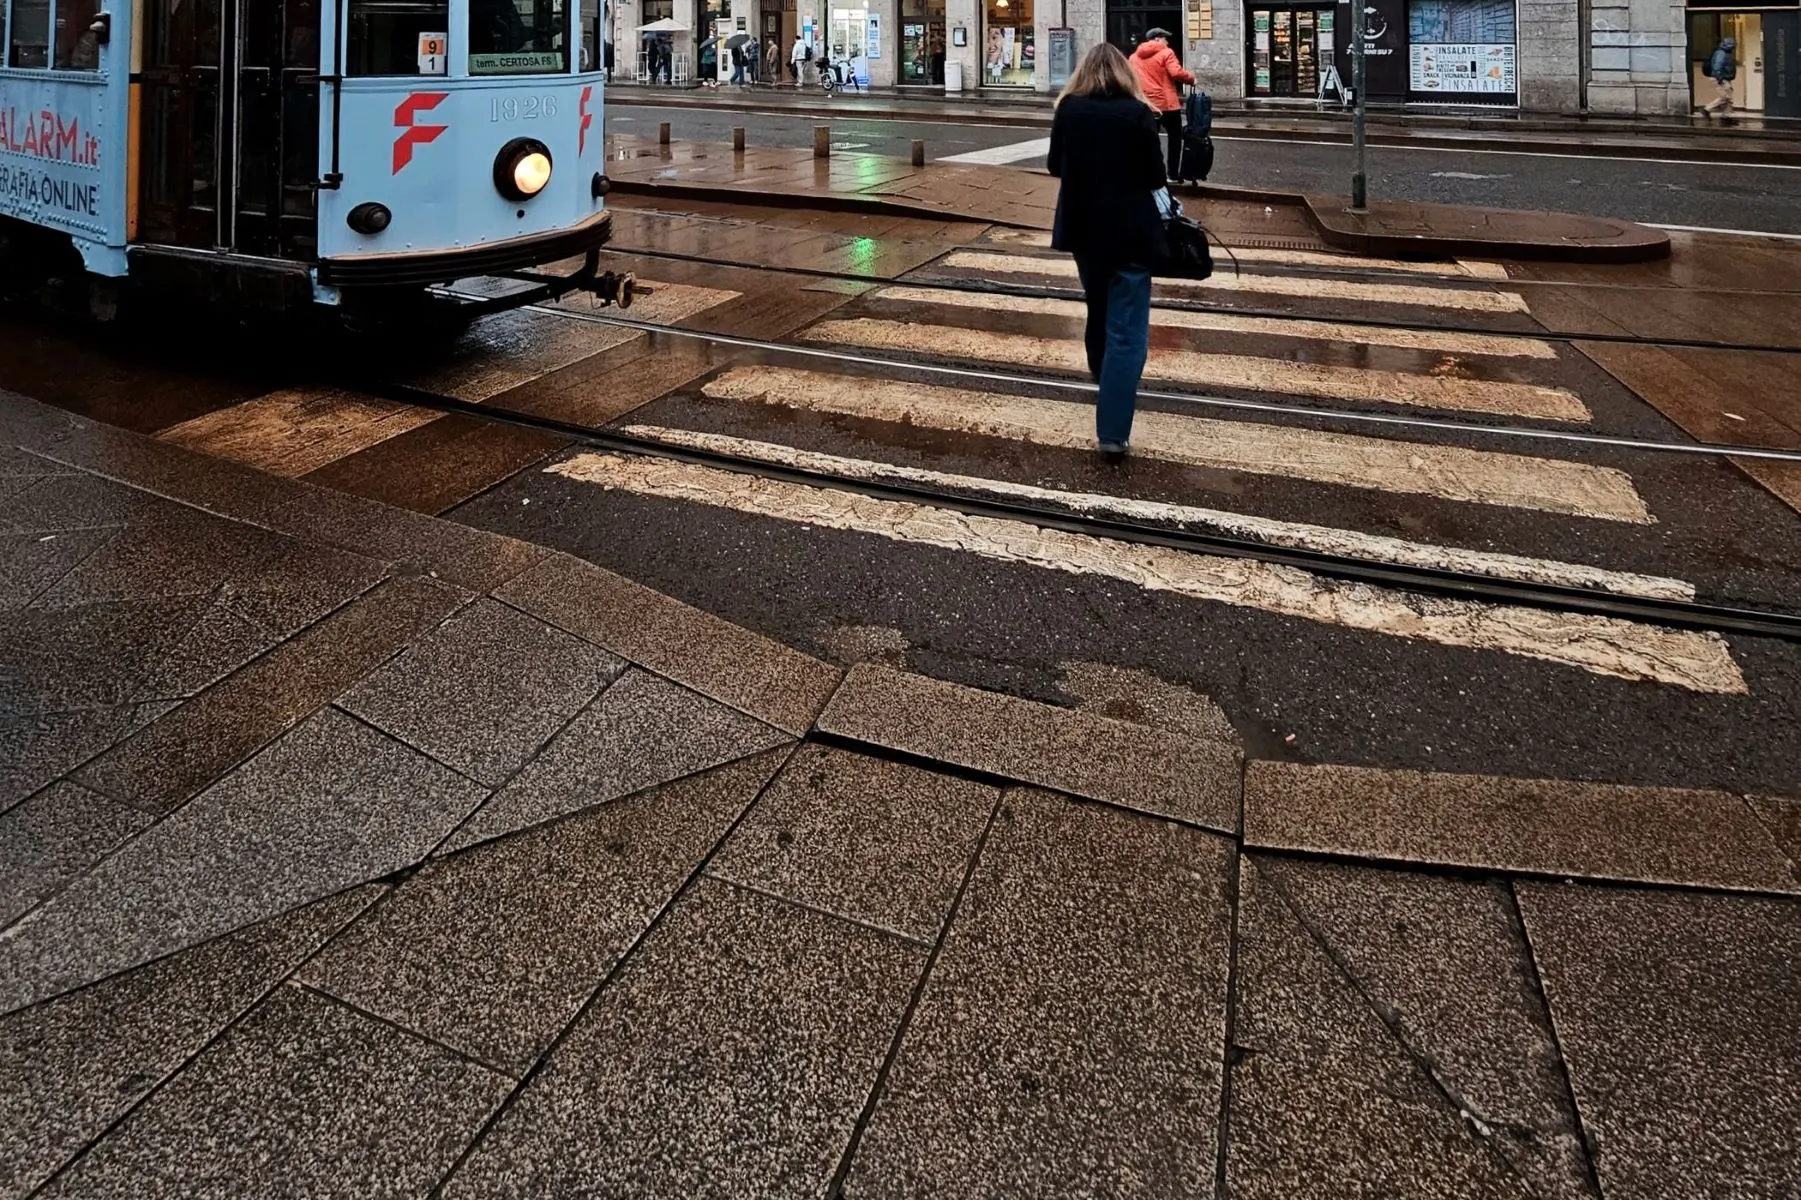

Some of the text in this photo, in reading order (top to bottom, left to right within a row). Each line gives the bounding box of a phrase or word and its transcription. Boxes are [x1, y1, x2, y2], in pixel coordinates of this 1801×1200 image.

[428, 39, 437, 54] 9
[1438, 46, 1476, 55] INSALATE
[428, 56, 435, 71] 1
[476, 56, 552, 69] term. CERTOSA FS
[490, 95, 558, 123] 1926
[41, 176, 97, 217] ONLINE
